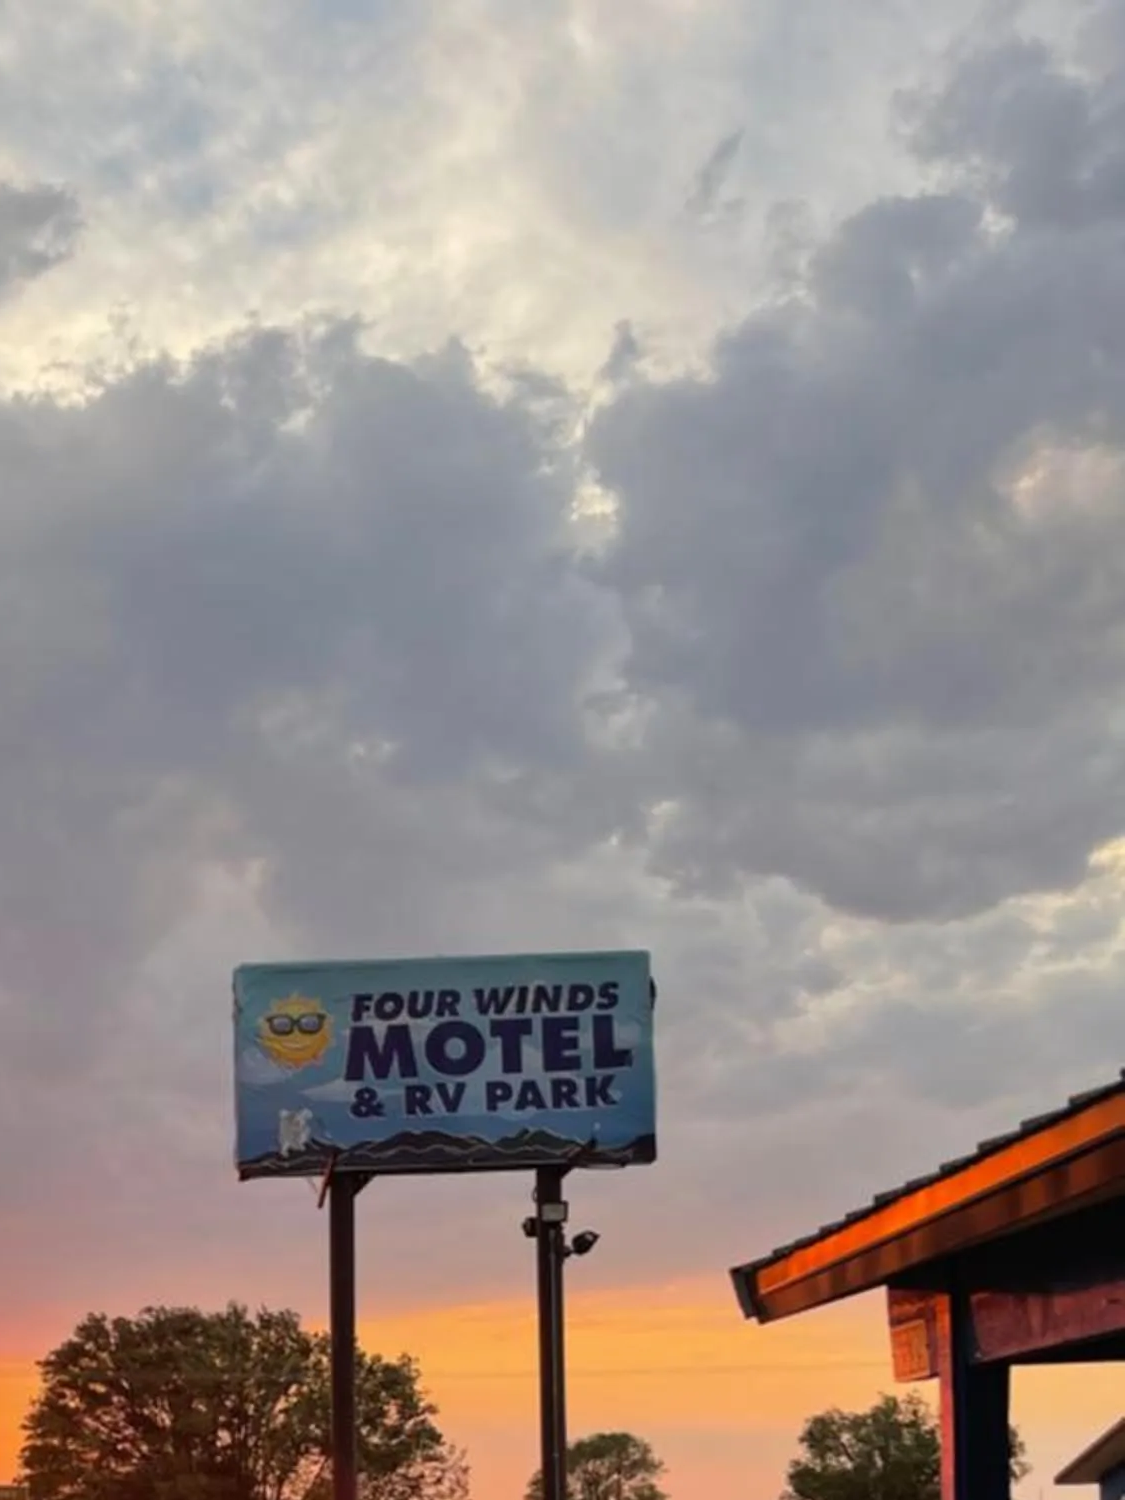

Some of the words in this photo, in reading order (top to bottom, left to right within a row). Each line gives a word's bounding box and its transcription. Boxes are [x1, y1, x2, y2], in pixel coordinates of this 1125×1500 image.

[350, 989, 462, 1022] FOUR
[473, 981, 620, 1016] WINDS
[344, 1014, 634, 1081] MOTEL
[350, 1086, 386, 1118] &
[404, 1082, 467, 1116] RV
[486, 1074, 618, 1112] PARK
